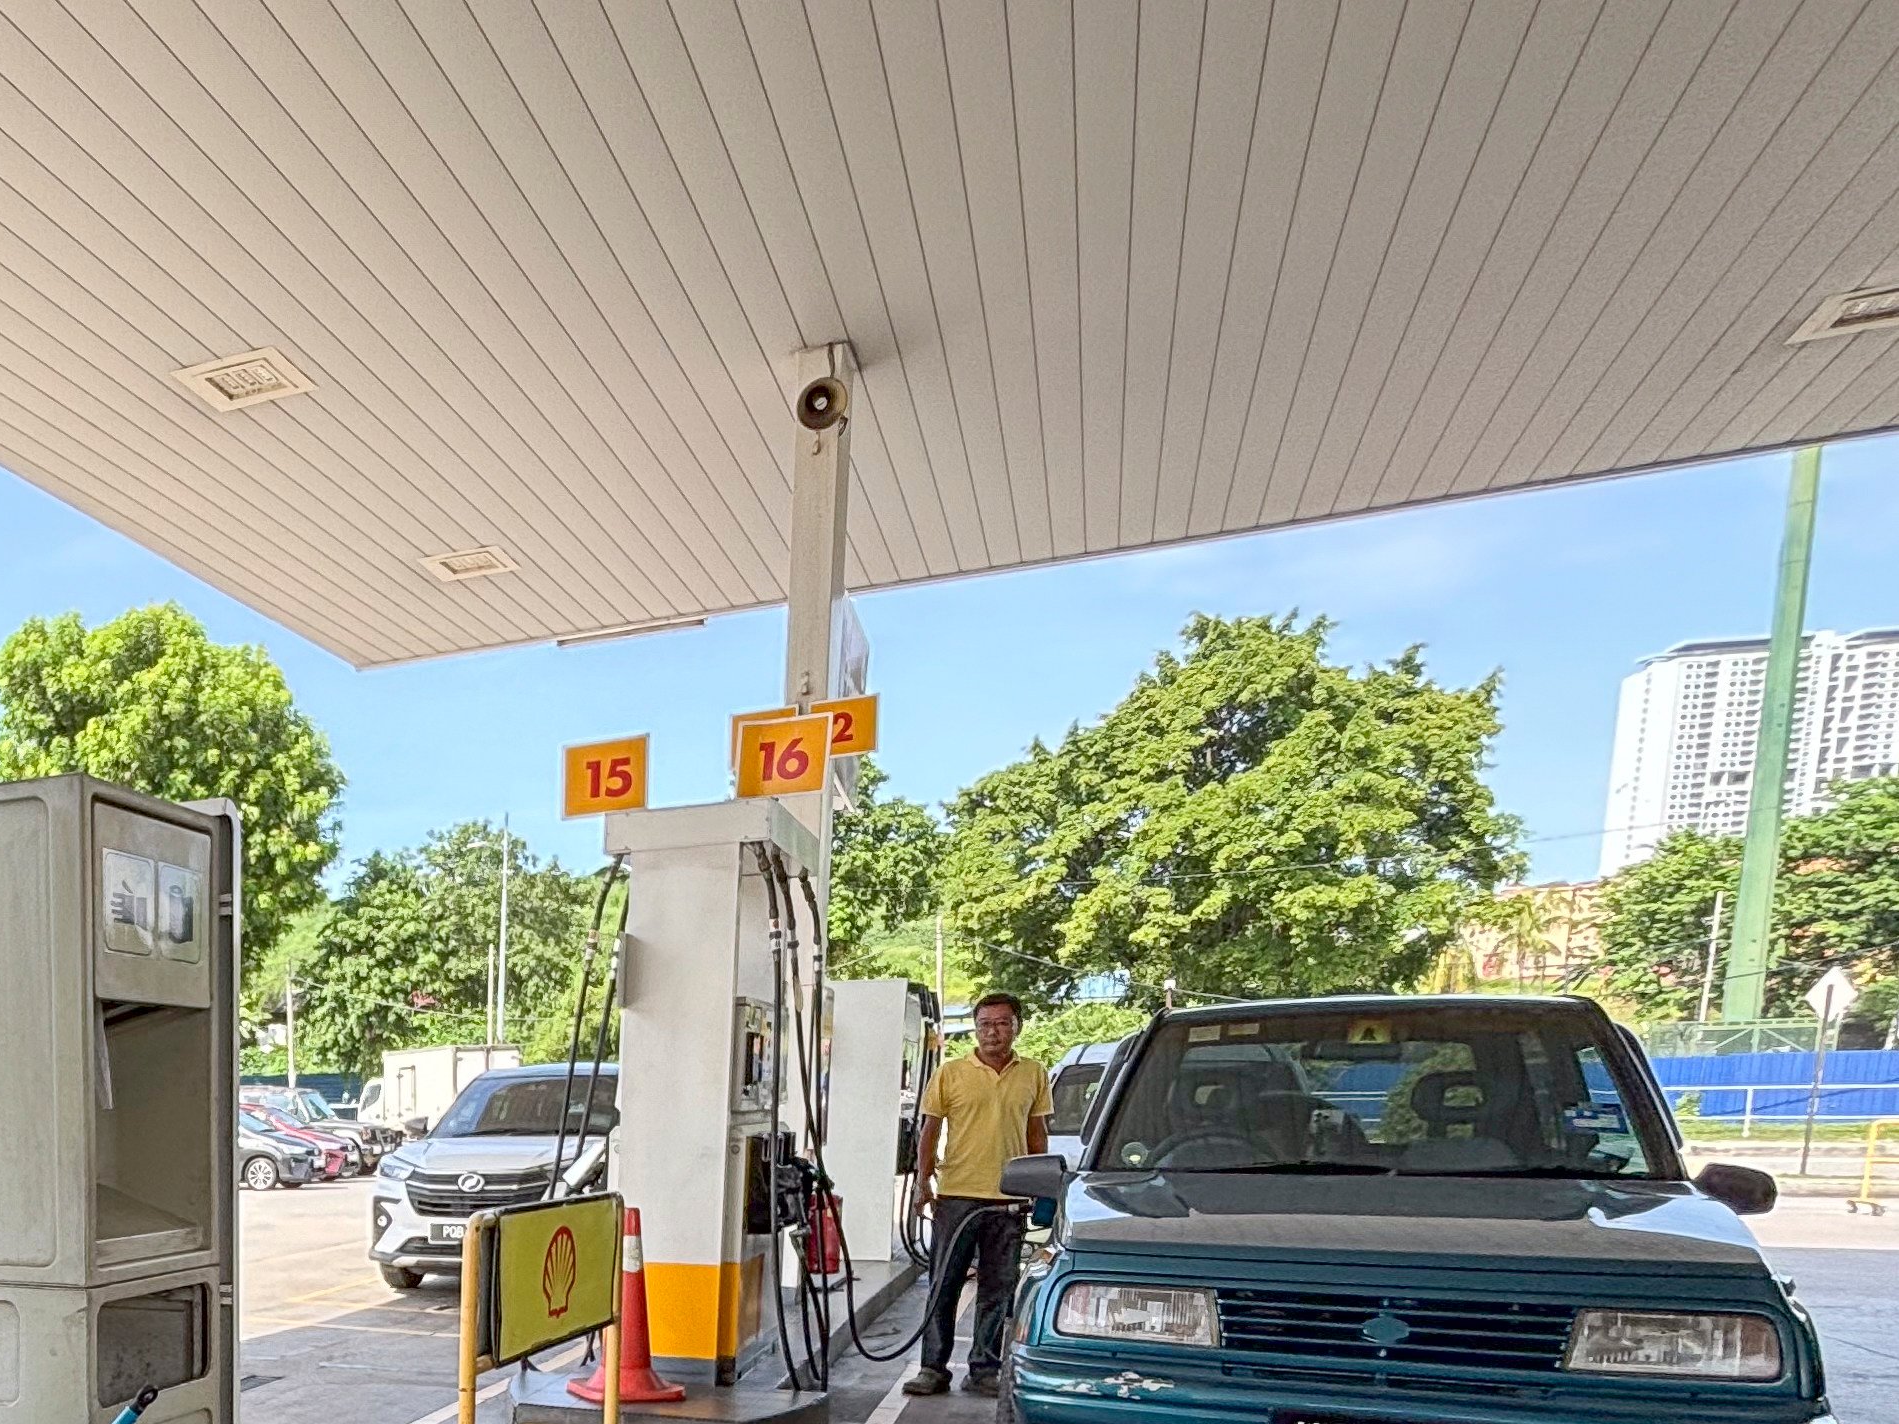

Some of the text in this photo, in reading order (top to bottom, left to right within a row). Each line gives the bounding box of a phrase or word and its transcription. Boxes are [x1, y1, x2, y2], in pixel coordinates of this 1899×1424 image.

[832, 711, 854, 744] 2
[585, 757, 633, 798] 15
[759, 737, 809, 782] 16
